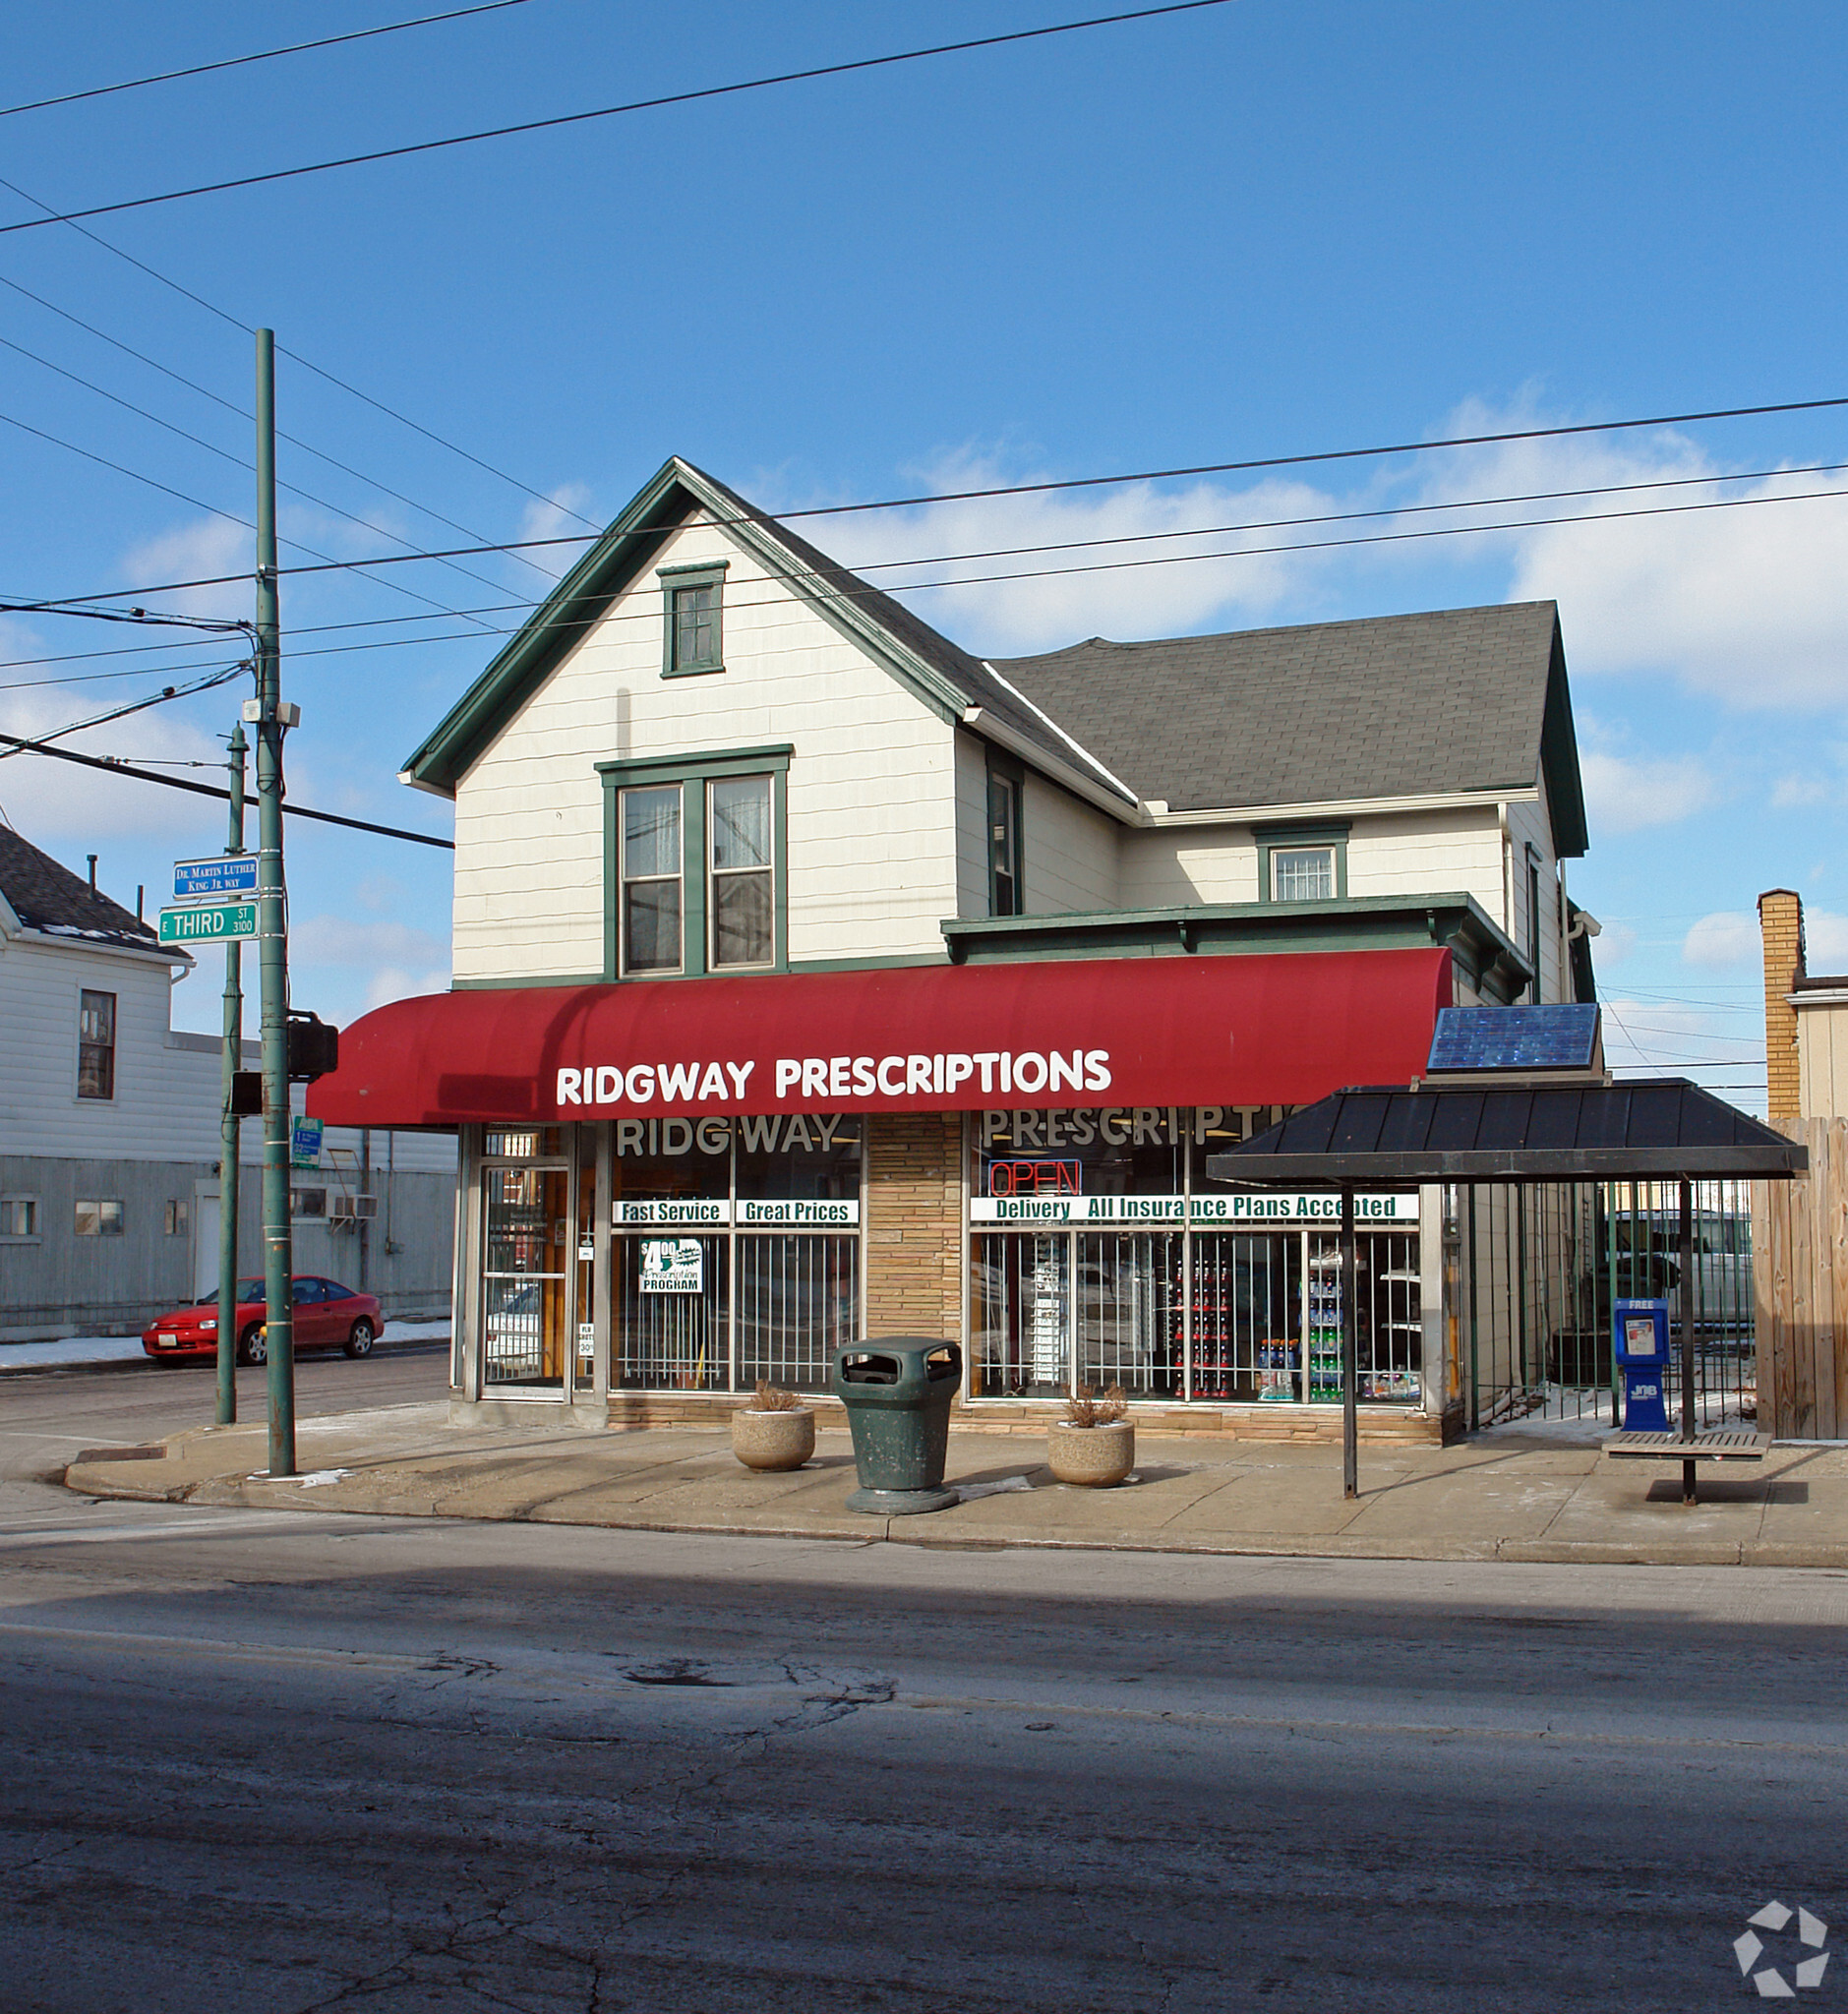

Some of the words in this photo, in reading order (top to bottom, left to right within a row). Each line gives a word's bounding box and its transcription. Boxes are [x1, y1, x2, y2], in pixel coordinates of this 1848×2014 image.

[192, 866, 222, 878] MARTIN
[223, 863, 256, 875] LUTHER
[188, 880, 209, 892] KING
[225, 878, 240, 888] WAY
[161, 920, 168, 932] E
[173, 912, 224, 936] THIRD
[238, 907, 248, 919] ST
[232, 919, 253, 932] 3100
[556, 1060, 755, 1106] RIDGWAY
[775, 1048, 1112, 1099] PRESCRIPTIONS
[616, 1112, 843, 1157] RIDGWAY
[983, 1104, 1311, 1149] PRESCRIPT
[990, 1159, 1080, 1197] OPEN
[622, 1203, 655, 1221] Fast
[658, 1202, 720, 1220] Service
[745, 1202, 791, 1220] Great
[795, 1202, 849, 1221] Prices
[996, 1198, 1071, 1220] Delivery
[1088, 1197, 1113, 1217] All
[1120, 1197, 1227, 1217] Insurance
[1233, 1196, 1290, 1216] Plans
[643, 1279, 698, 1290] PROGRAM
[1629, 1300, 1654, 1309] FREE
